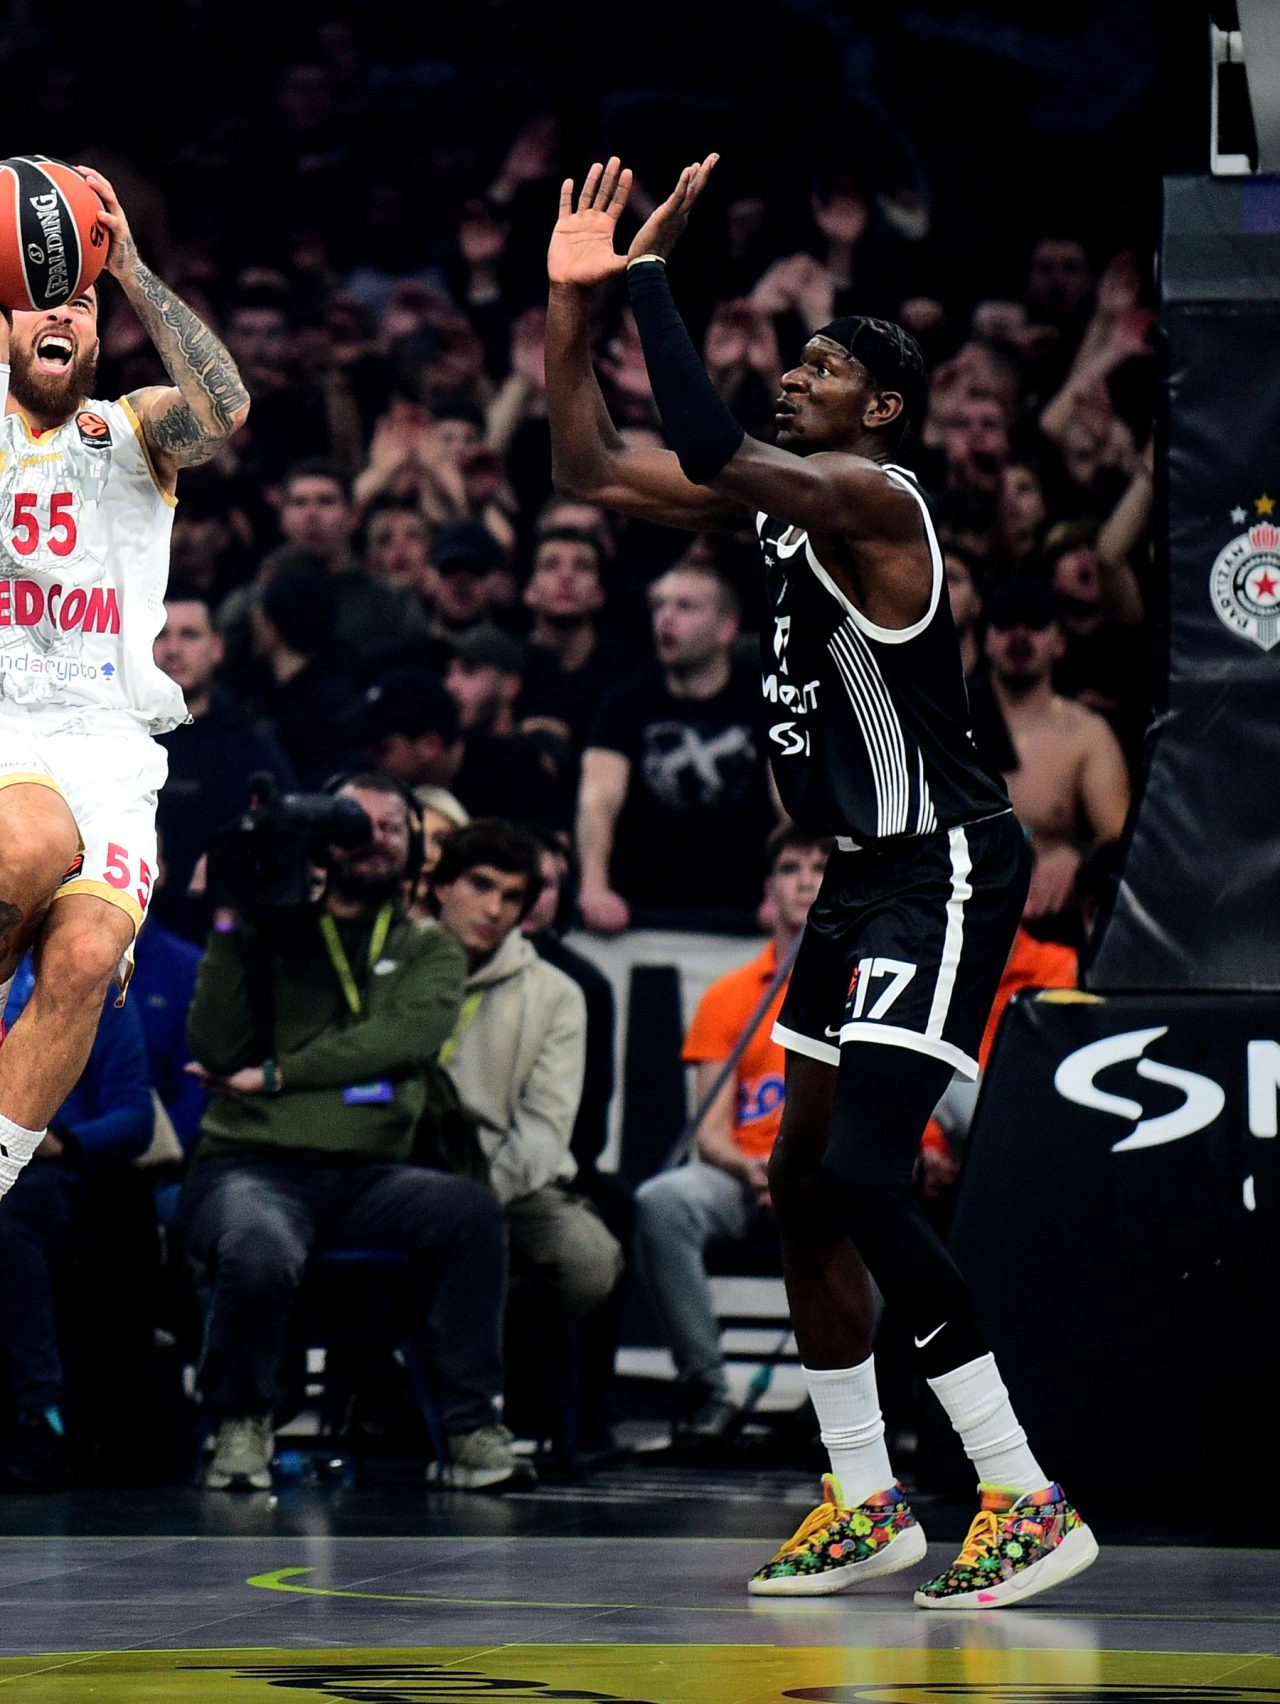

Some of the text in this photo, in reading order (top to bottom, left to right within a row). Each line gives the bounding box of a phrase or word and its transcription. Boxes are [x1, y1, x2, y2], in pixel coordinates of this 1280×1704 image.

[29, 189, 68, 298] SPALDING
[11, 492, 77, 556] 55
[852, 957, 917, 1020] 17
